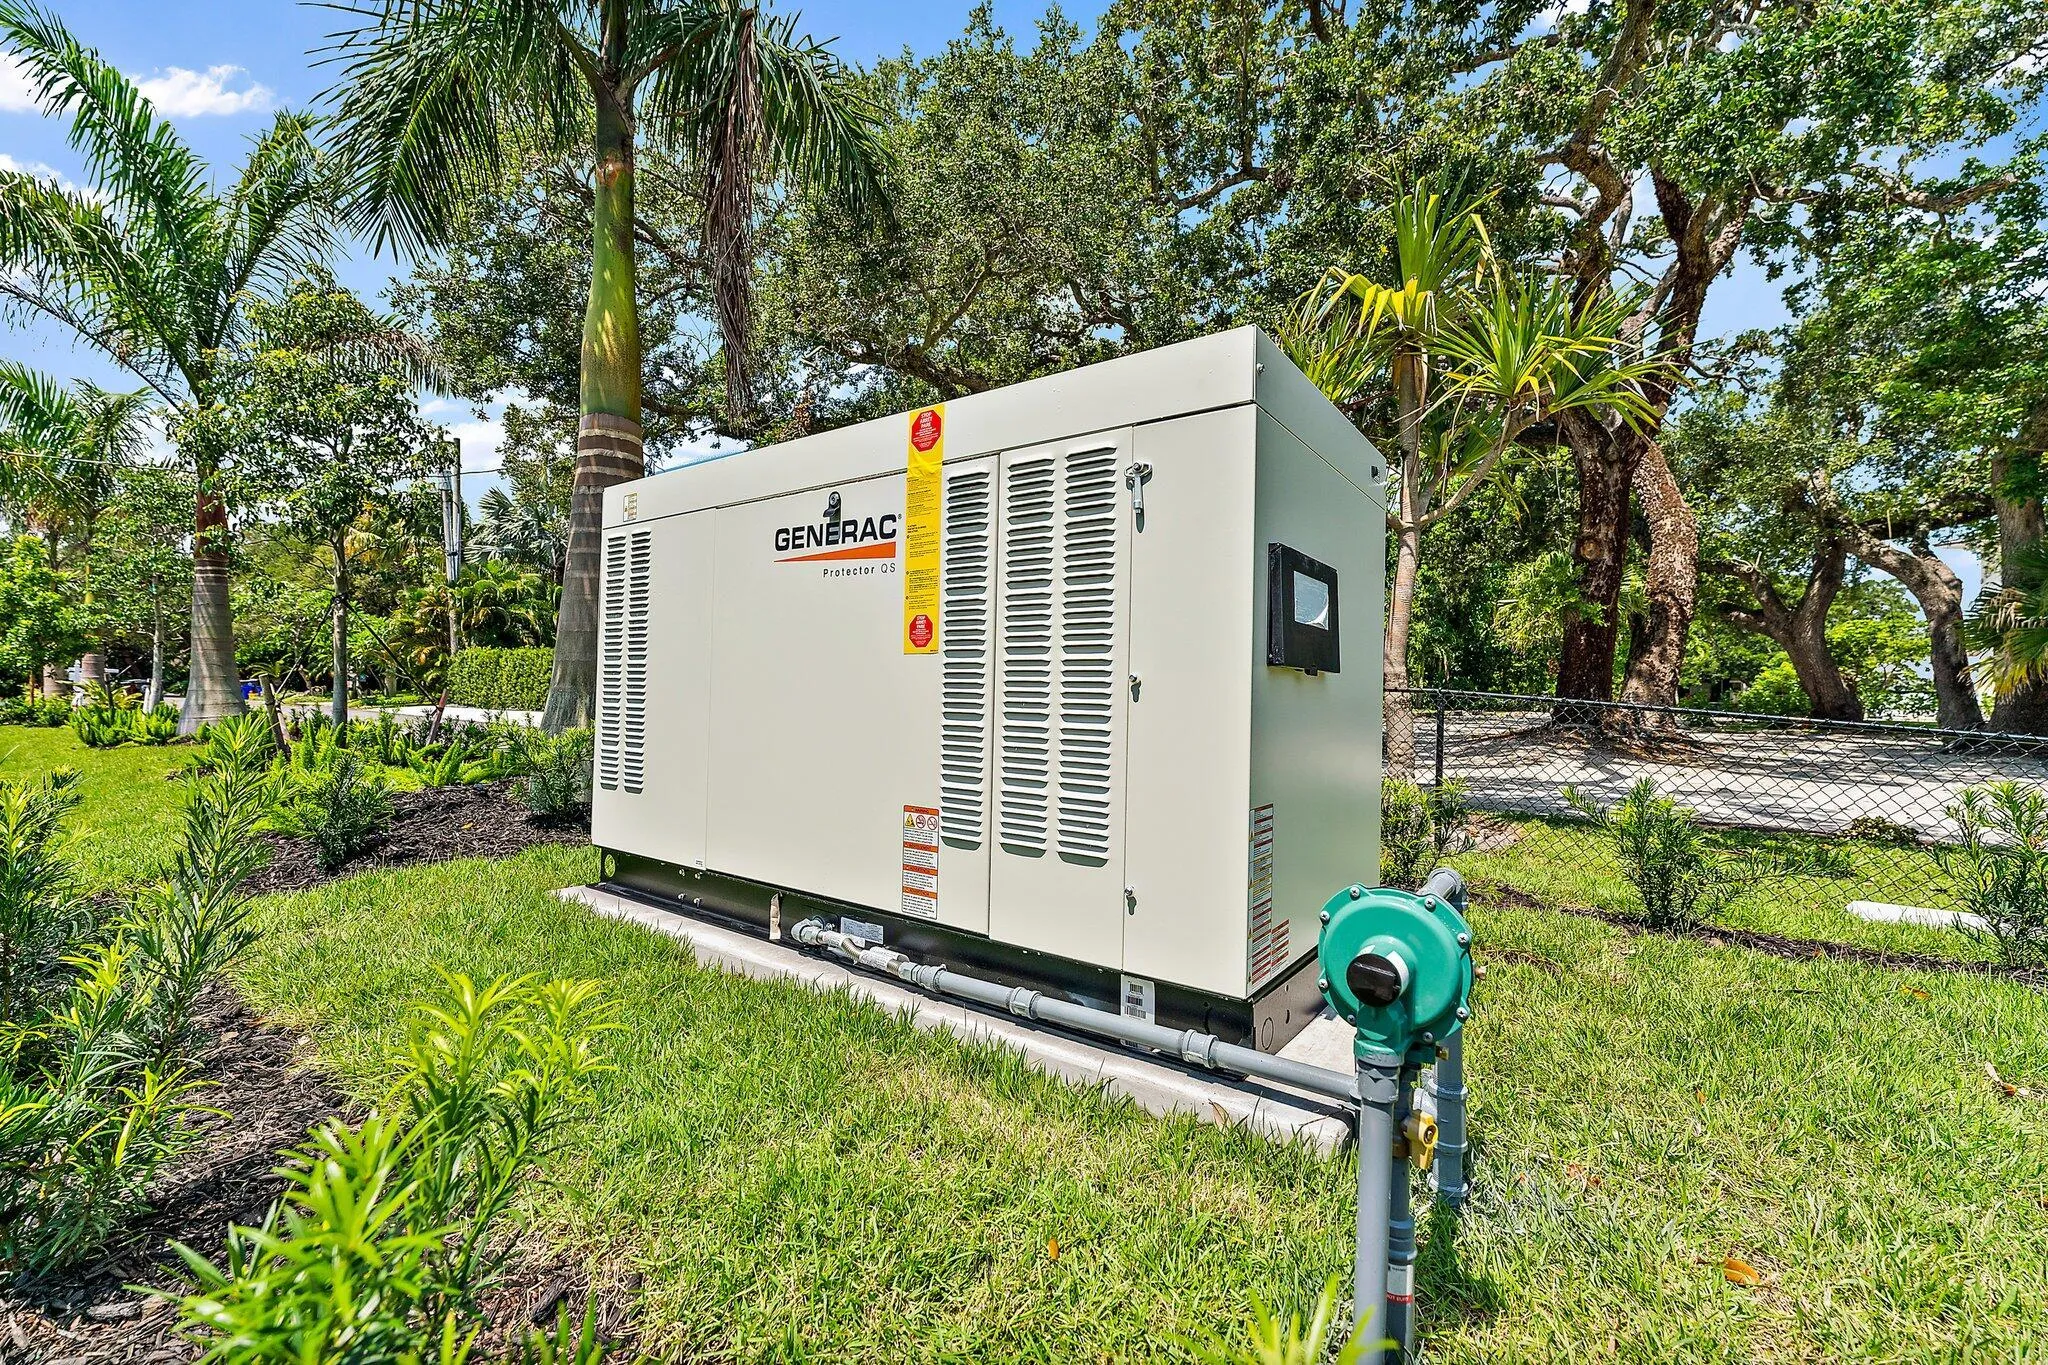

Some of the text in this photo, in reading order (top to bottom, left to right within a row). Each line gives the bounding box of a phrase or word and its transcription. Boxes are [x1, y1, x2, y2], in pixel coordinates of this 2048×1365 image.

[774, 514, 897, 551] GENERAC
[823, 562, 896, 578] Protector QS
